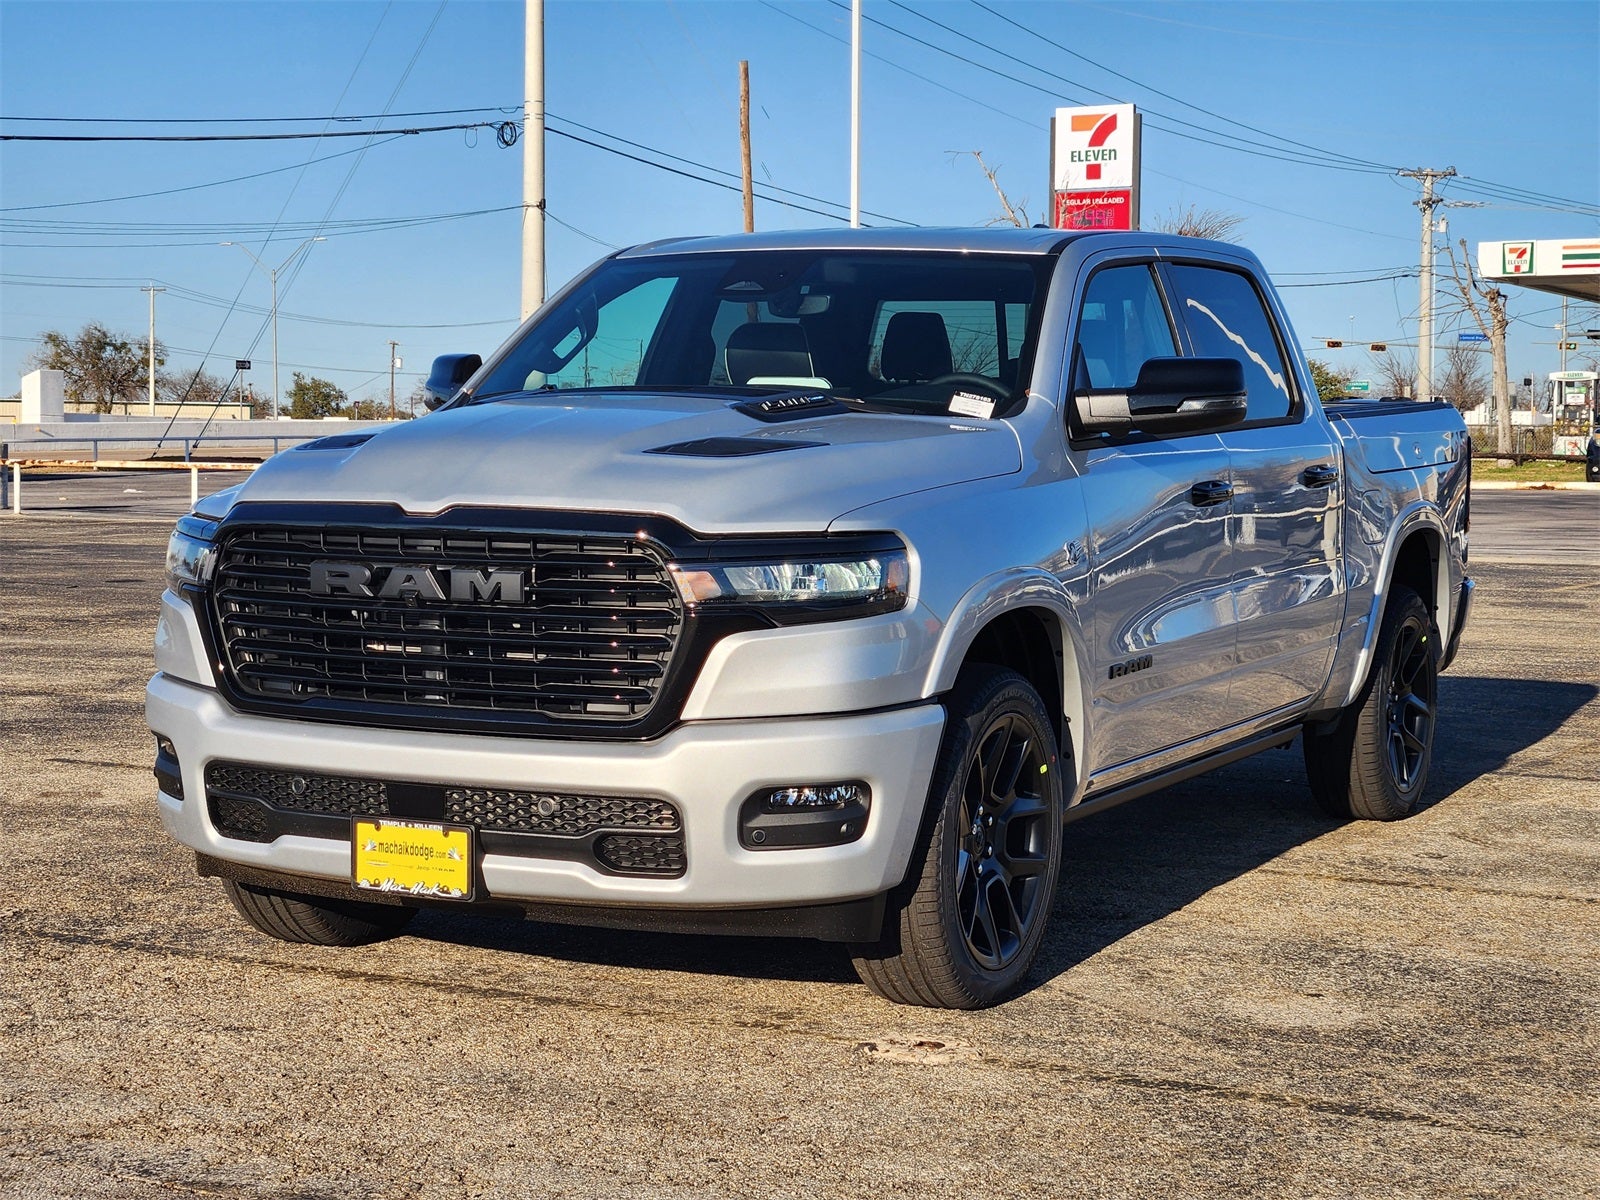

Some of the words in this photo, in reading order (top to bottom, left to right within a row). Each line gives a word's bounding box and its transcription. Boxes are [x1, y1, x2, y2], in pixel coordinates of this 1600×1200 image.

[1071, 113, 1117, 180] 7
[310, 559, 525, 604] RAM
[1108, 654, 1153, 680] RAM
[379, 820, 406, 828] TEMPLE
[414, 823, 443, 831] KILLEEN
[379, 842, 446, 860] machaikdodge.com
[379, 877, 407, 892] Mac
[410, 881, 442, 895] Haik
